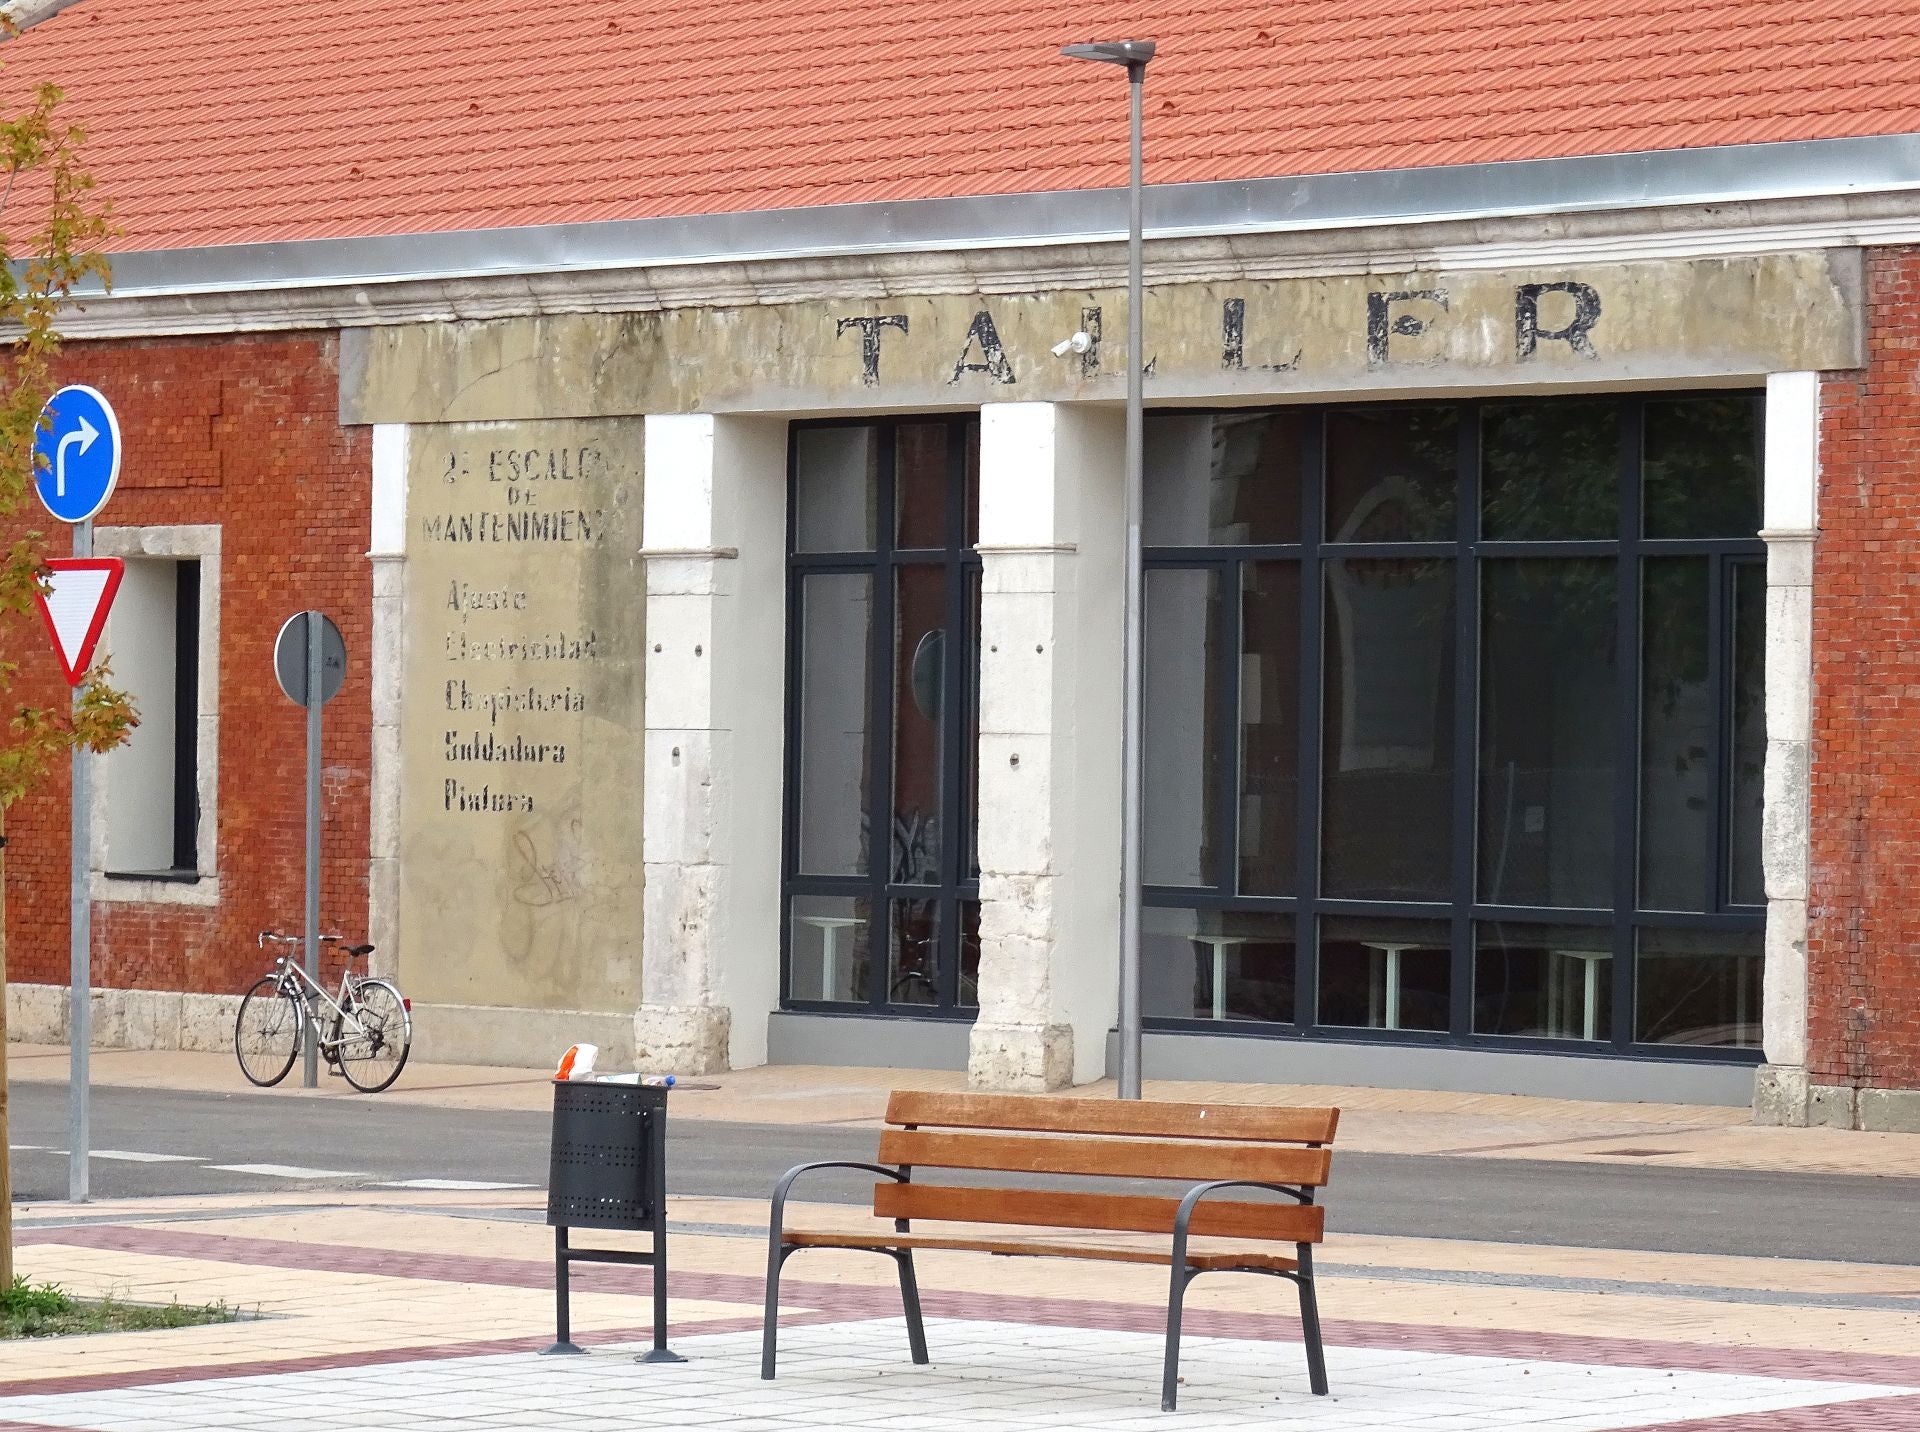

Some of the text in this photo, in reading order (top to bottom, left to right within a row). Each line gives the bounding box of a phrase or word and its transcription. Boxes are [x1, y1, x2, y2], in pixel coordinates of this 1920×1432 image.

[837, 281, 1602, 389] TALLER
[508, 486, 537, 506] DE
[422, 509, 603, 542] MANTENIMIEN
[447, 579, 526, 625] Ajuste
[446, 730, 565, 763] Soldadura
[445, 778, 534, 812] Pintura
